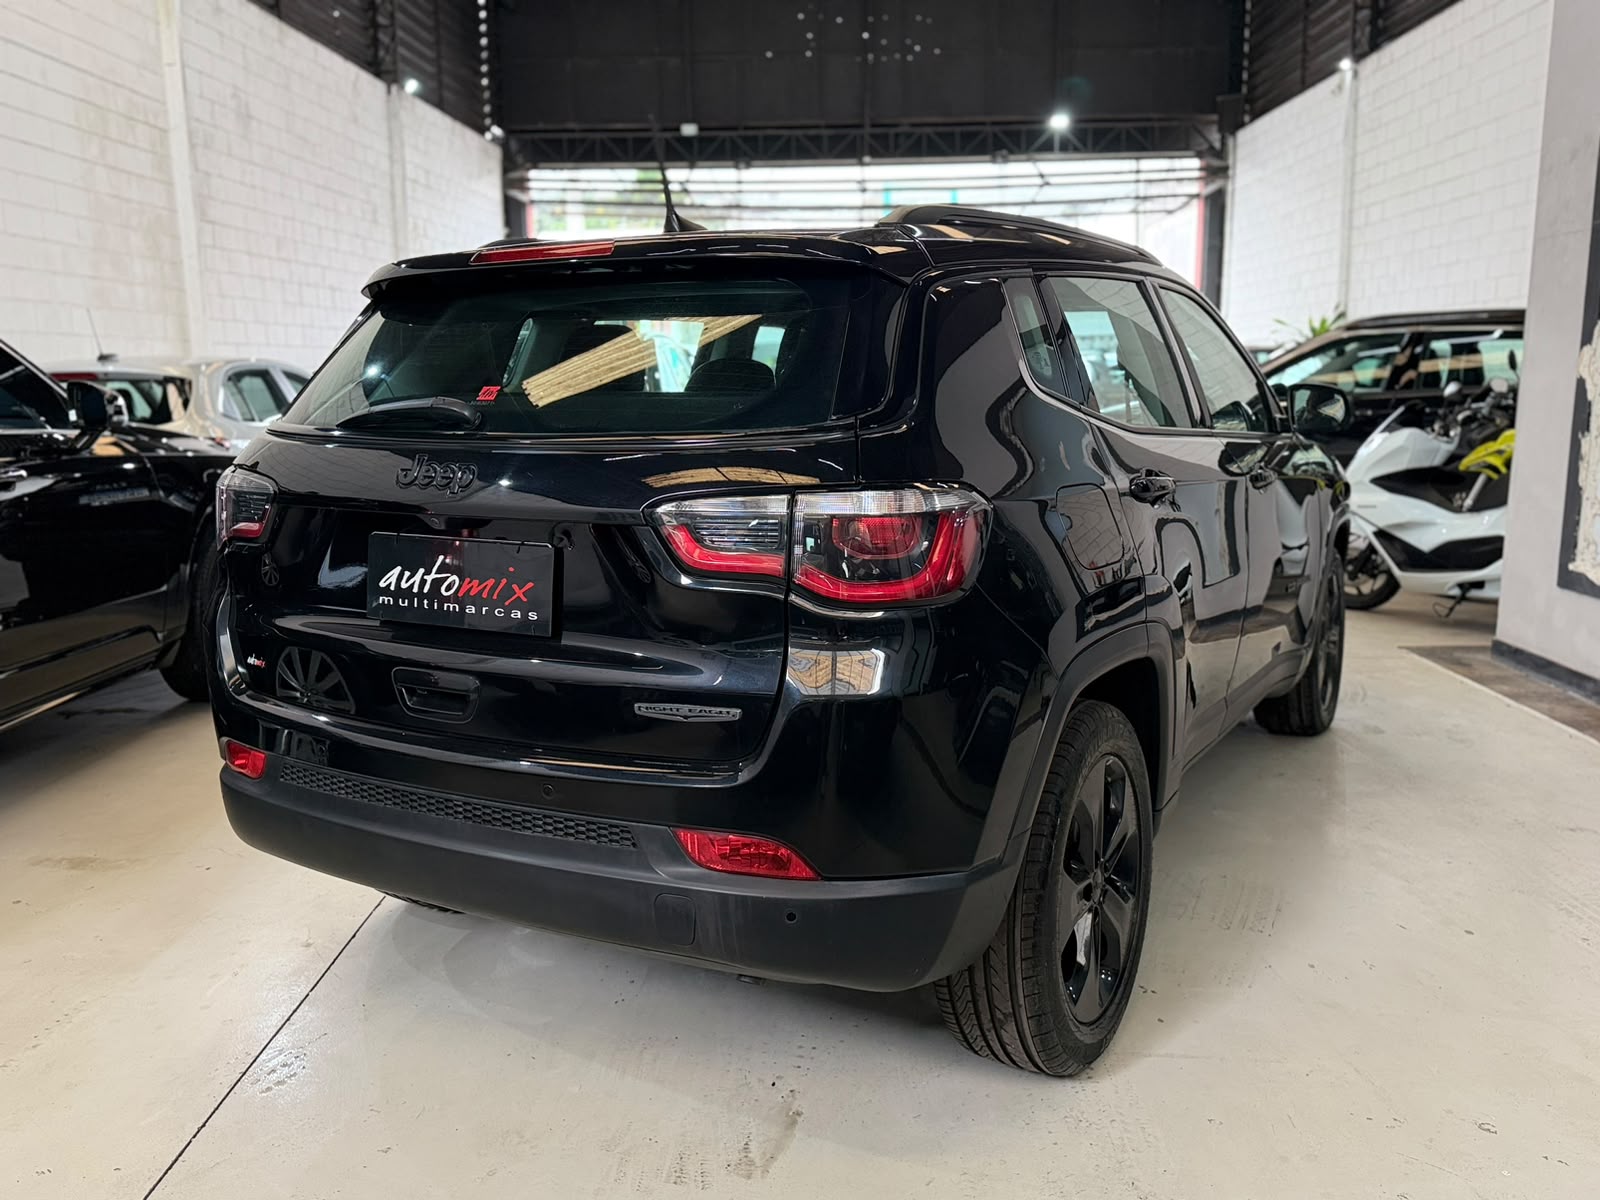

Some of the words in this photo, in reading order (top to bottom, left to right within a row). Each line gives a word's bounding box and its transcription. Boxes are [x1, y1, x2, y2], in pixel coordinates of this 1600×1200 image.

[396, 454, 479, 497] Jeep
[378, 554, 535, 606] automix
[379, 595, 538, 621] multimarcas
[637, 704, 683, 713] NIGHT
